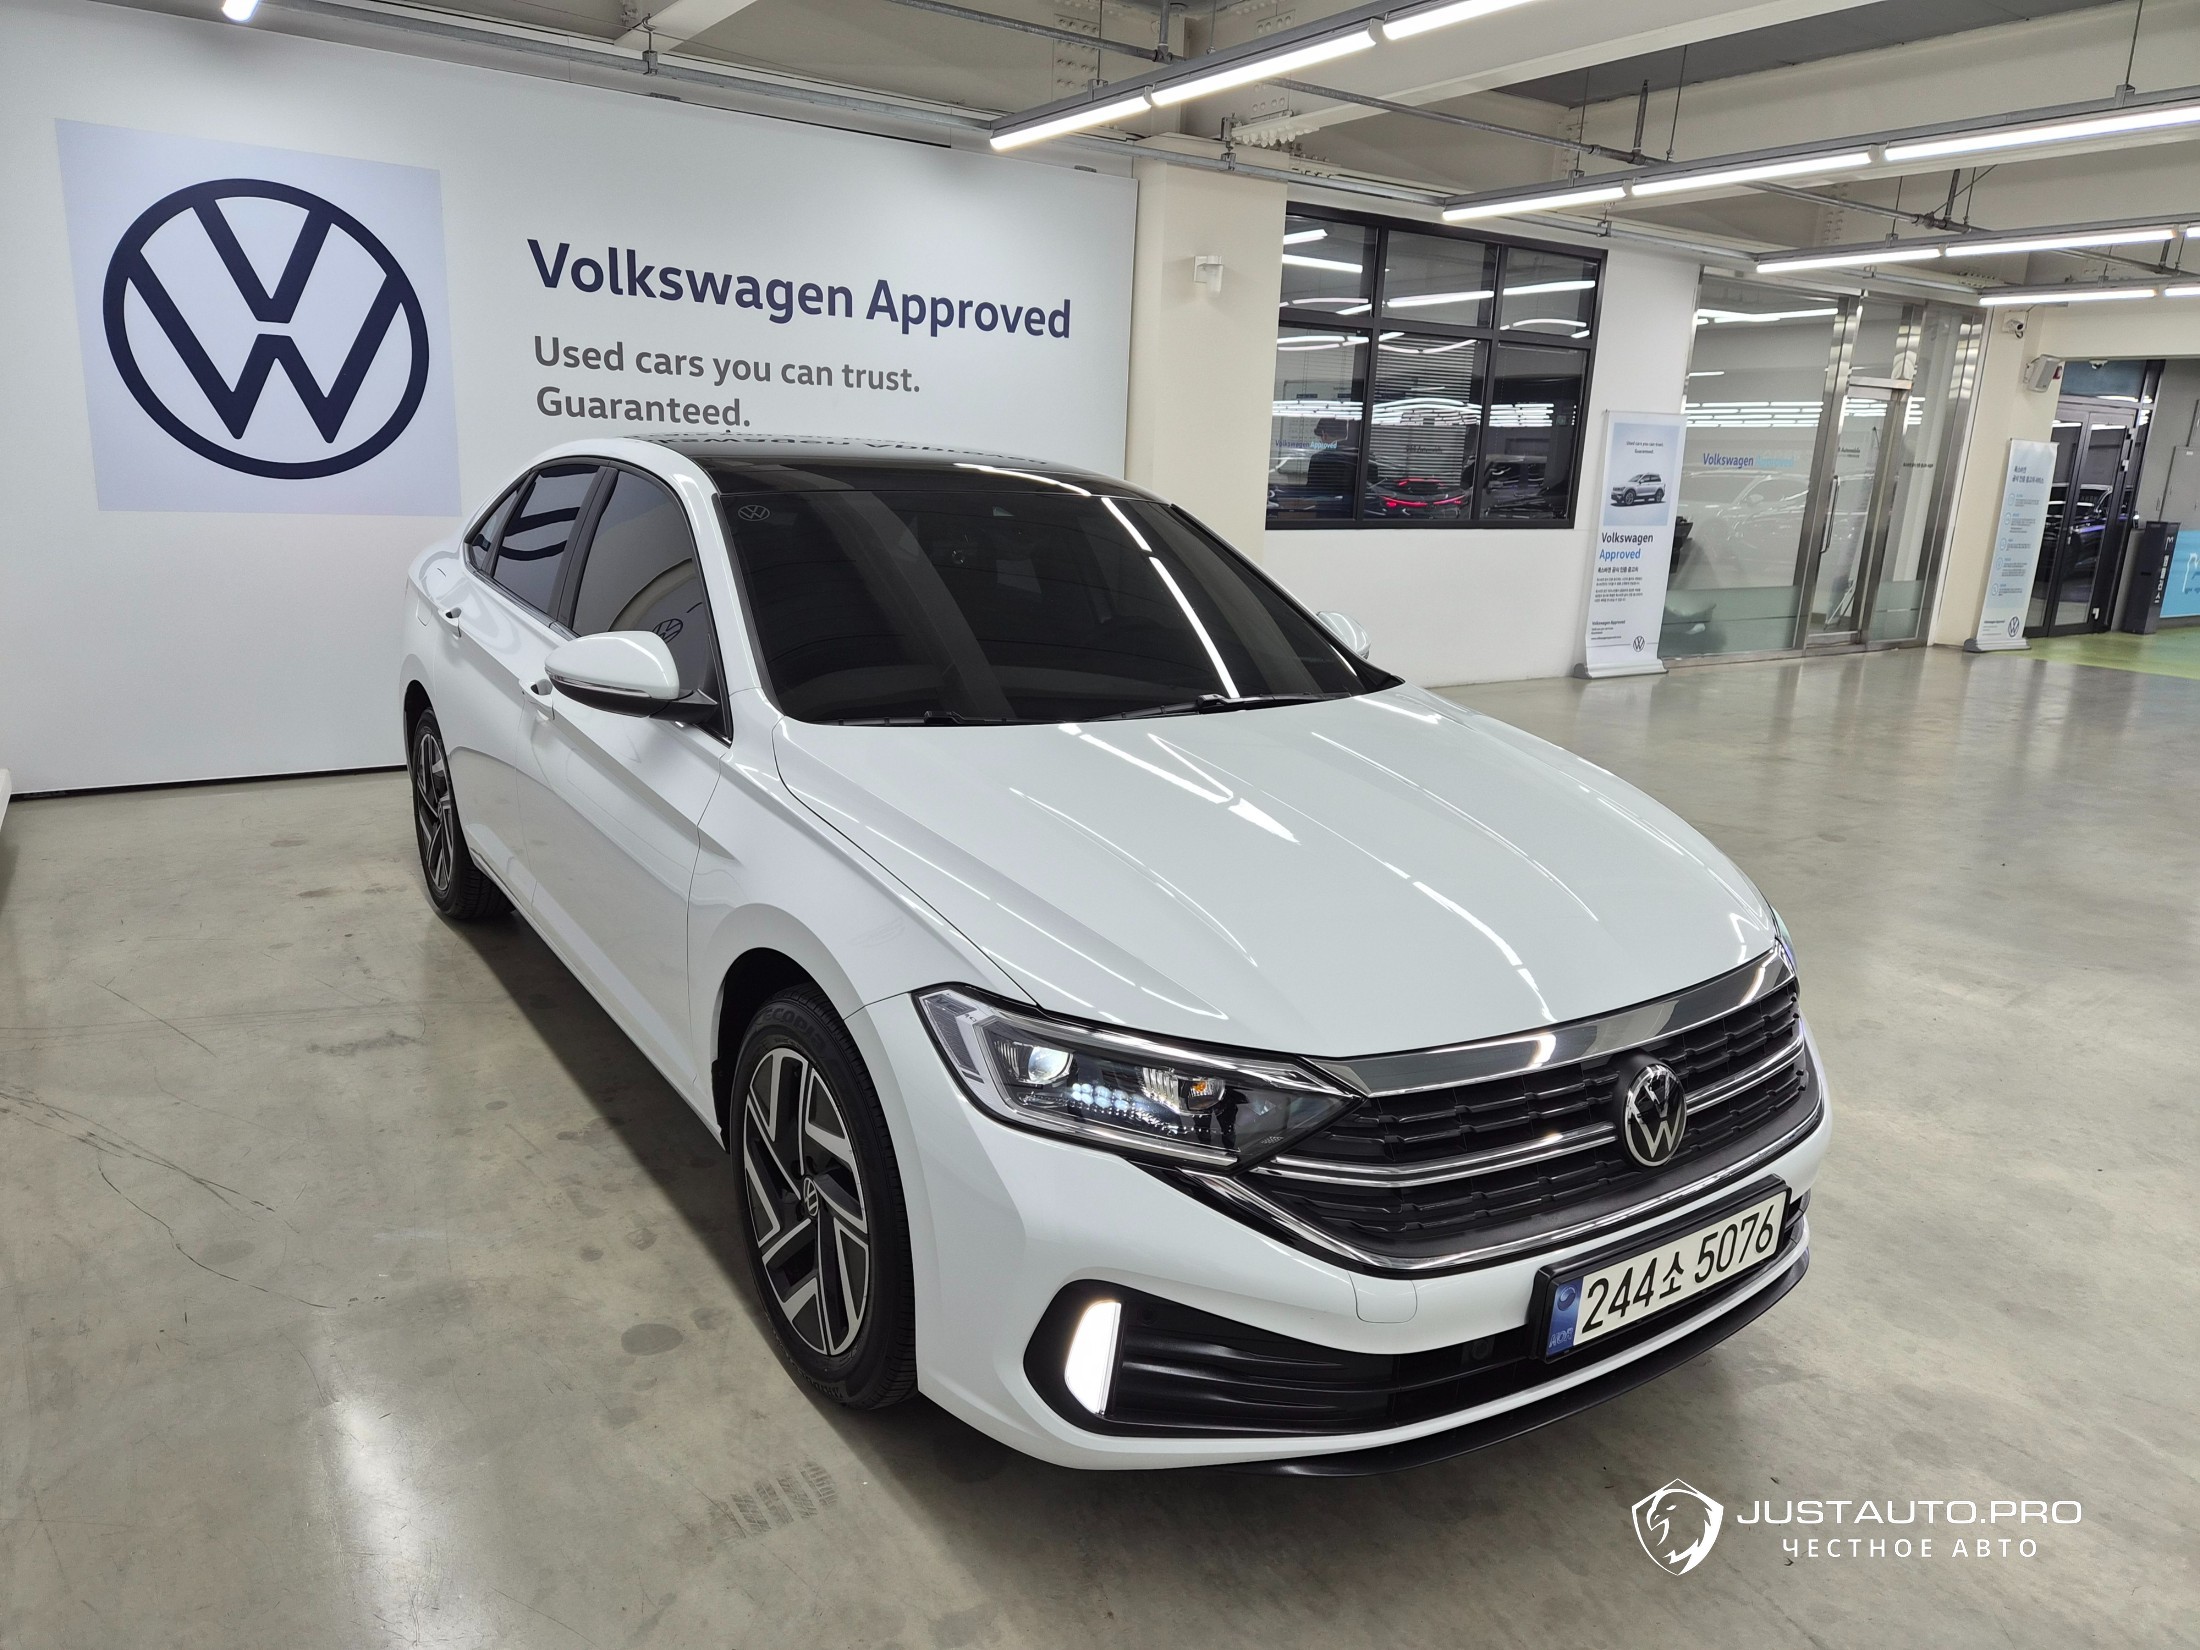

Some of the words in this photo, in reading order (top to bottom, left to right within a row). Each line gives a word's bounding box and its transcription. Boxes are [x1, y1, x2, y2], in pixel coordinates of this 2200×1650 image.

[527, 238, 853, 325] Volkswagen
[865, 279, 1071, 338] Approved
[534, 336, 624, 372] Used
[635, 351, 705, 378] cars
[712, 357, 771, 387] you
[780, 363, 833, 387] can
[841, 364, 920, 393] trust.
[536, 386, 750, 427] Guaranteed.
[1310, 441, 1338, 450] Approved
[1703, 453, 1754, 469] Volkswagen
[1756, 454, 1795, 468] Approved
[1601, 532, 1654, 546] Volkswagen
[1599, 548, 1642, 562] Approved
[1582, 1251, 1685, 1334] 244소
[1694, 1204, 1775, 1284] 5076
